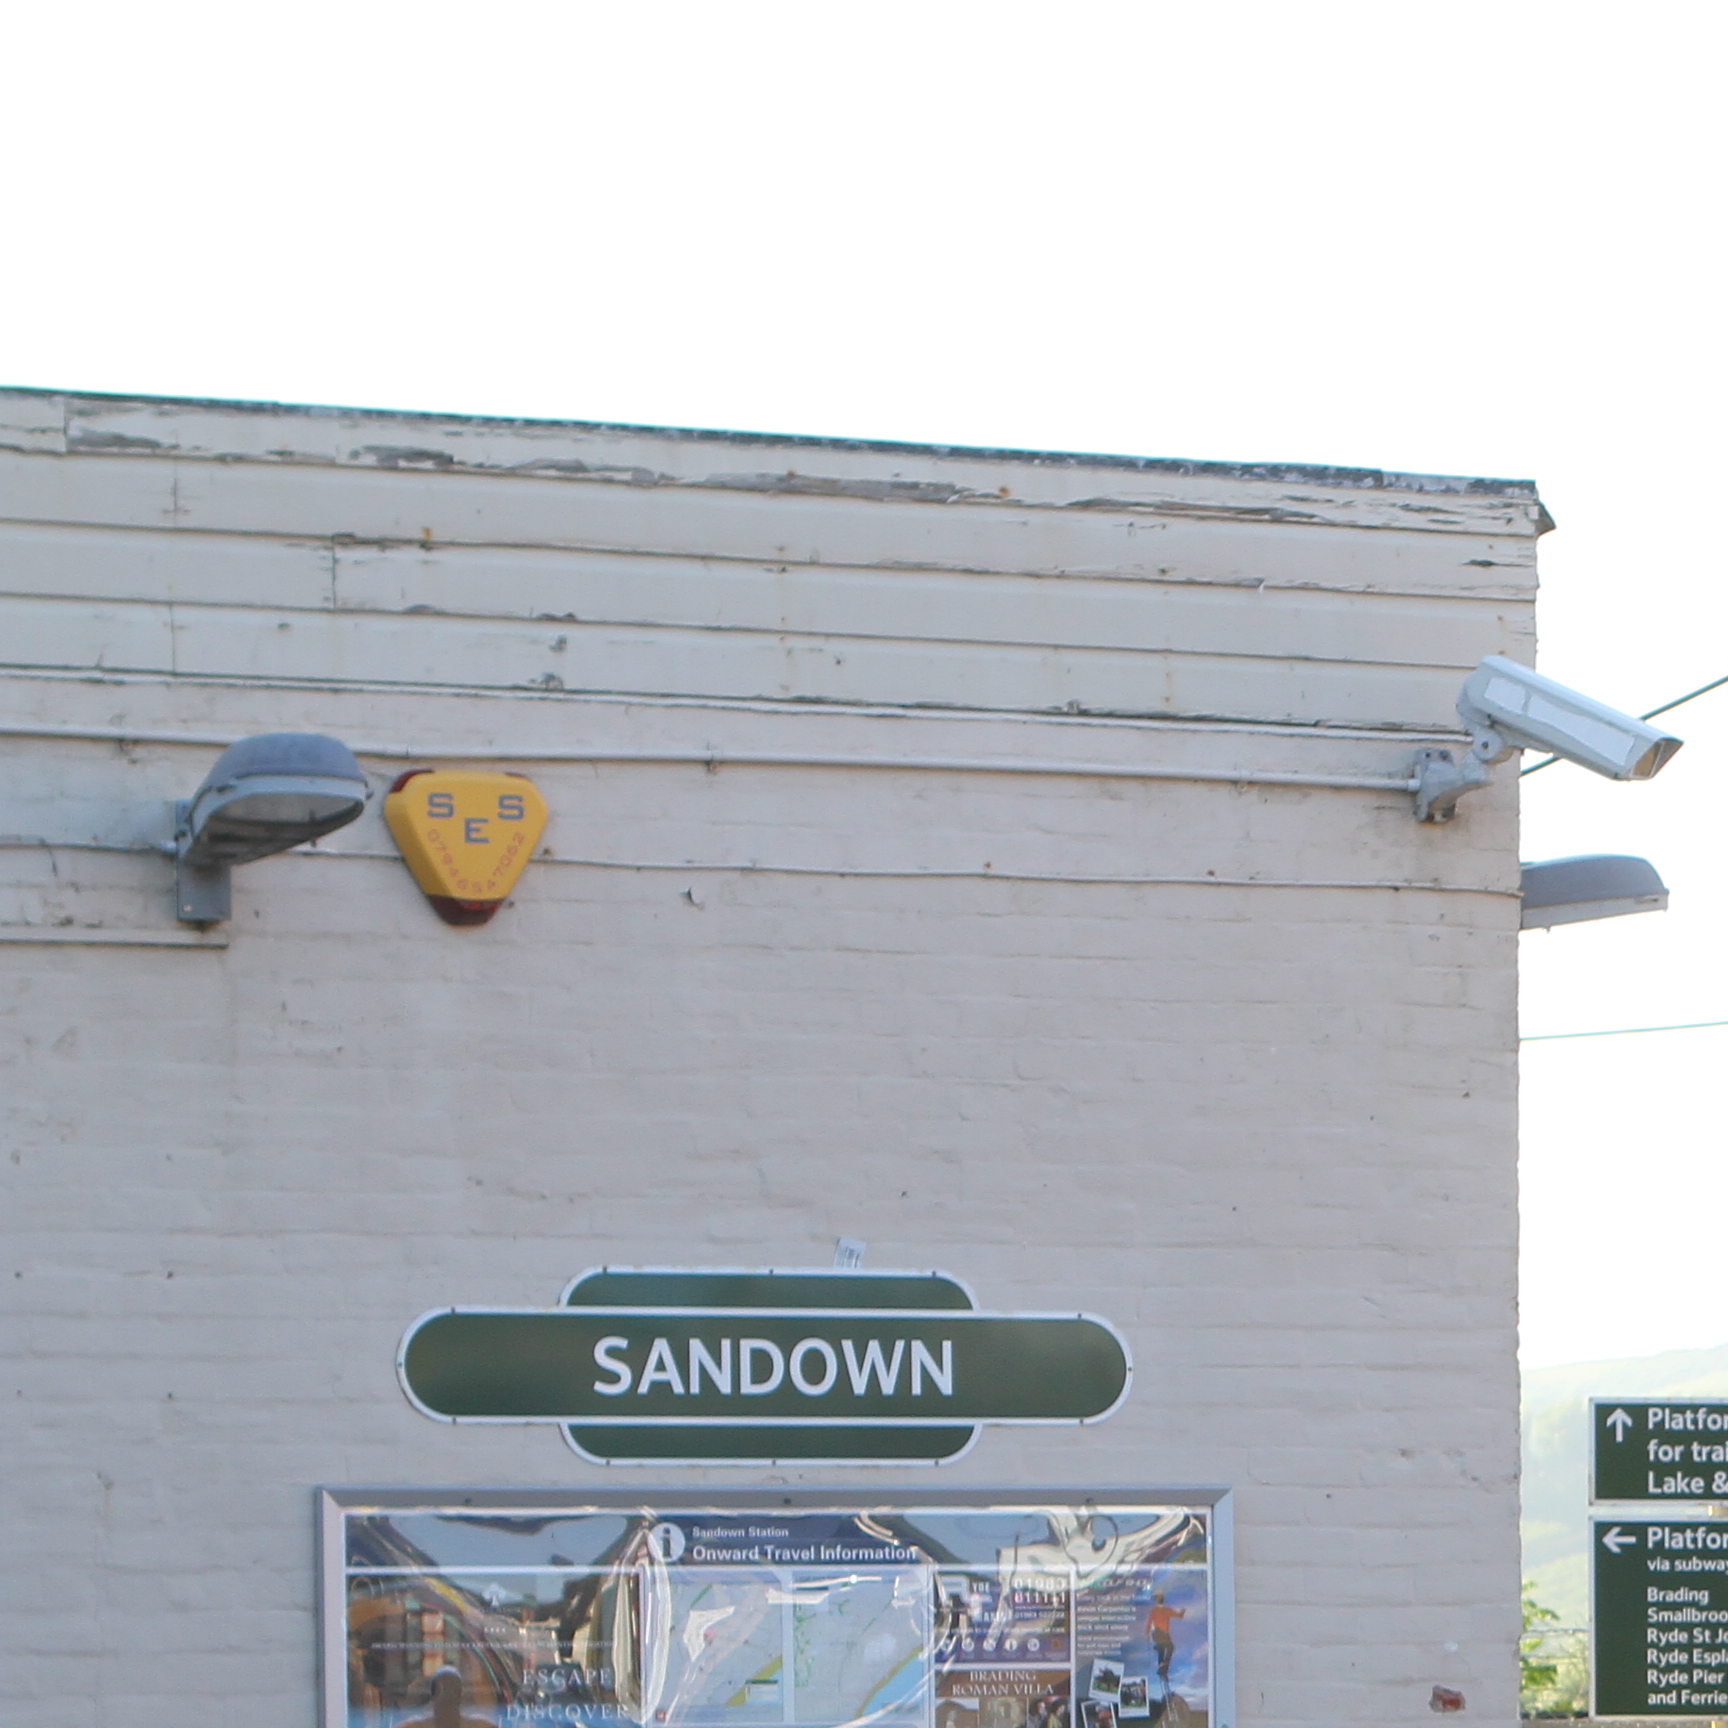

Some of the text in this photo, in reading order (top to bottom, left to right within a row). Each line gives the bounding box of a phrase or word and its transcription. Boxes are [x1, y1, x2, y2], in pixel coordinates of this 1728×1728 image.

[593, 1336, 954, 1397] SANDOWN
[1647, 1438, 1684, 1462] for
[1647, 1471, 1705, 1494] Lake
[692, 1526, 789, 1538] Sandown Station
[693, 1543, 917, 1561] Onward Travel Information
[1647, 1556, 1670, 1571] via
[1647, 1586, 1709, 1605] Brading
[1647, 1628, 1688, 1646] Ryde
[1693, 1628, 1711, 1644] St
[1647, 1648, 1688, 1667] Ryde
[523, 1668, 611, 1686] ESCAPE
[969, 1671, 1037, 1683] BRADING
[1647, 1669, 1688, 1688] Ryde
[1693, 1669, 1725, 1685] Pier
[952, 1683, 1054, 1697] ROMAN VILLA
[1647, 1690, 1676, 1705] and
[506, 1704, 628, 1721] DISCOVER
